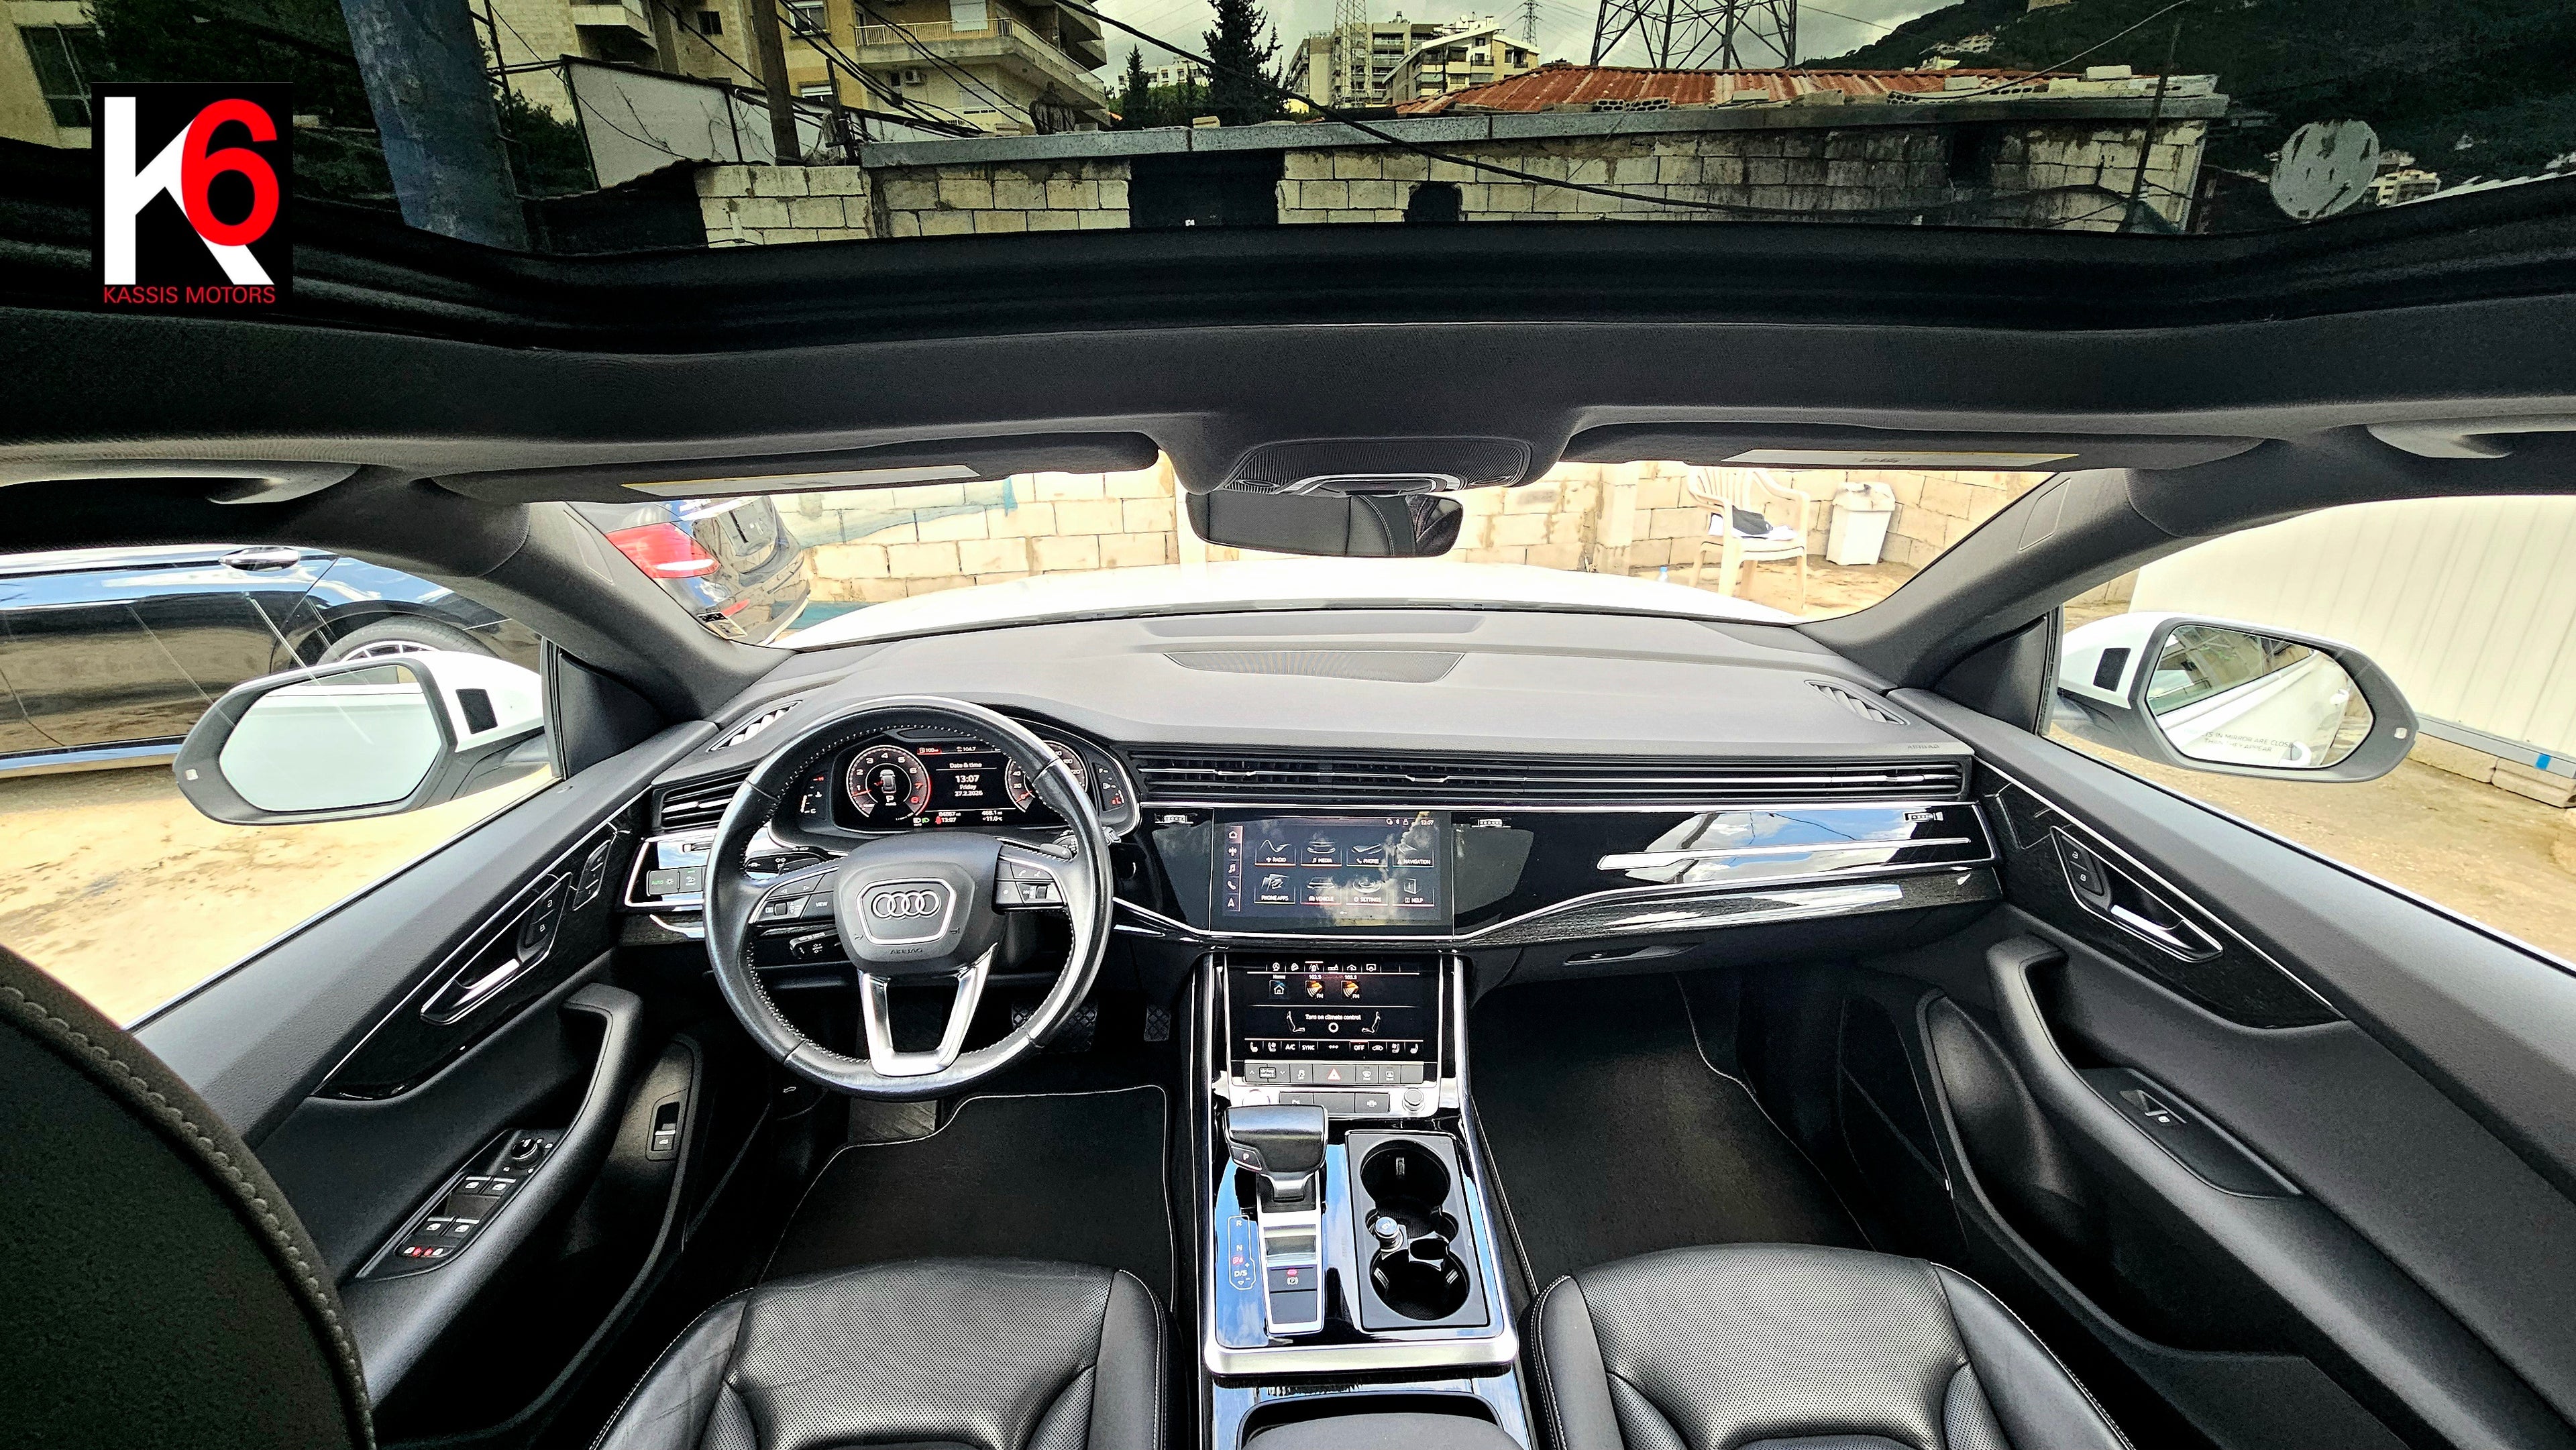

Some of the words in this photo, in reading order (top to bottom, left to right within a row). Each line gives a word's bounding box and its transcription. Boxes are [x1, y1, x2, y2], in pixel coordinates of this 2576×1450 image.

[2225, 734, 2252, 742] MIRROR
[955, 774, 979, 783] 13:07
[1242, 1153, 1250, 1161] P
[1234, 1270, 1248, 1278] D/S
